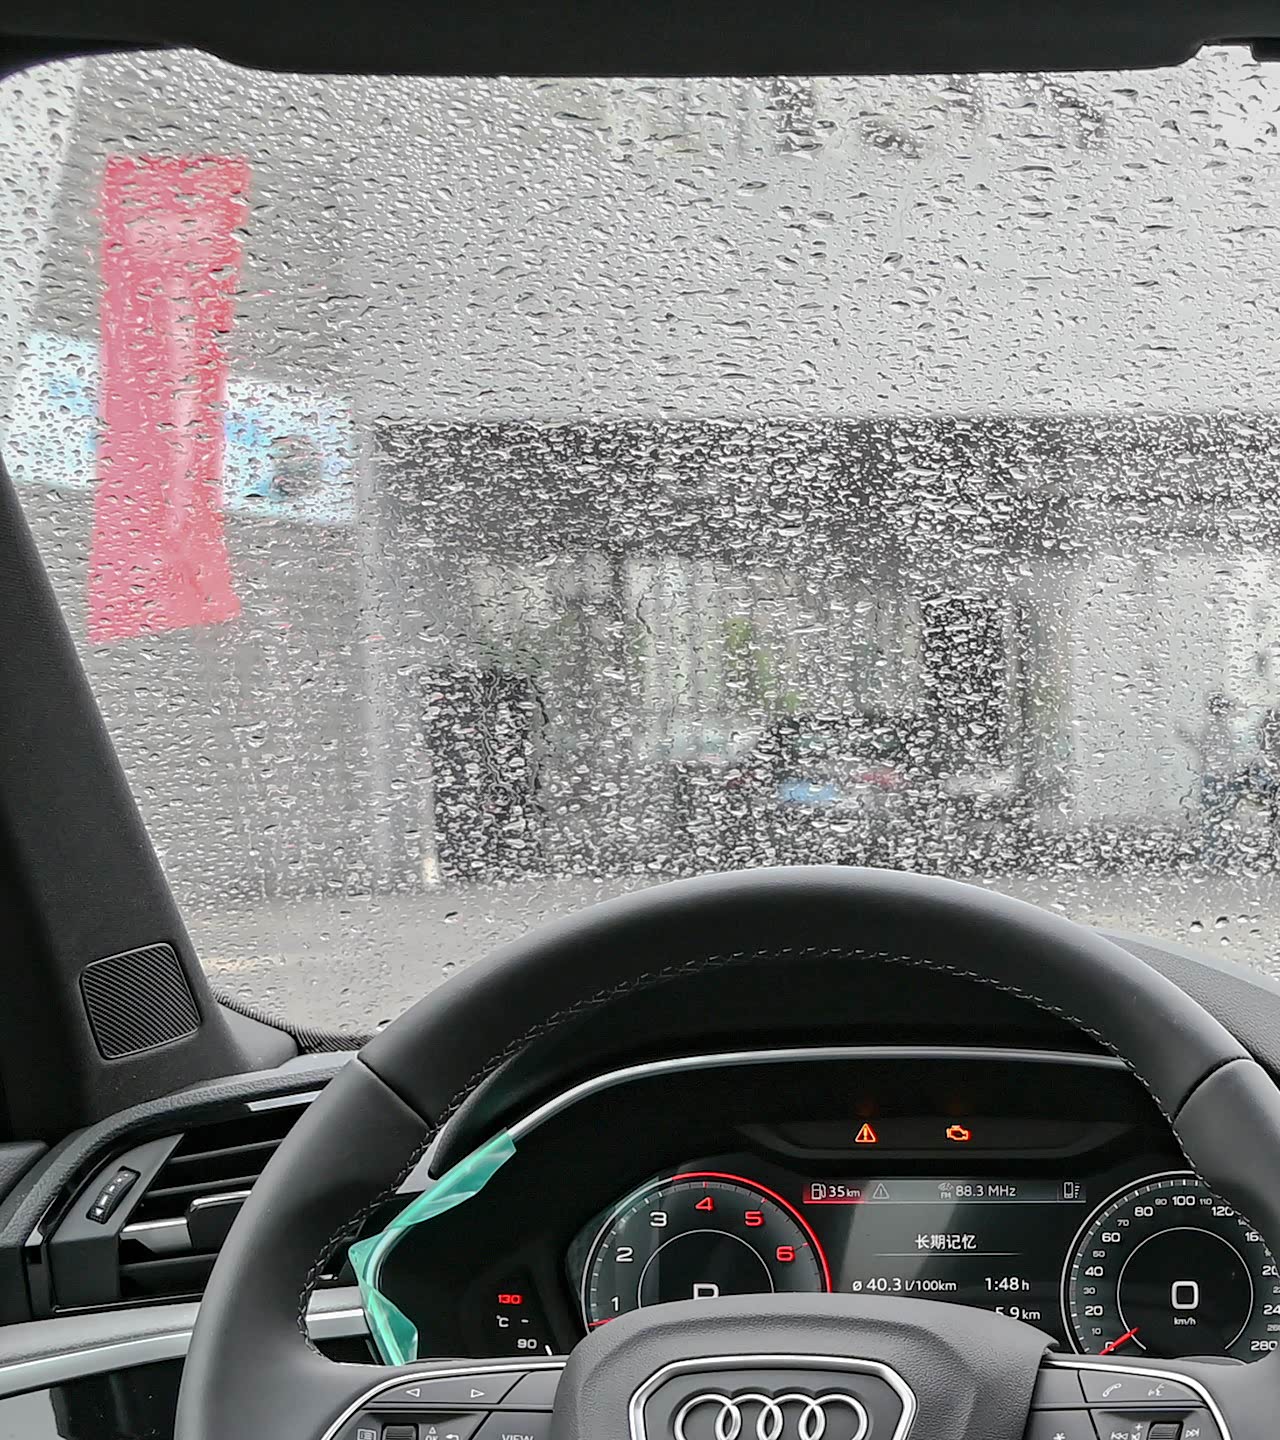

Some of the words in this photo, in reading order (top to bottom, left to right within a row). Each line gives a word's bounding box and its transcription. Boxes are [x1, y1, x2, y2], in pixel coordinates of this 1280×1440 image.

[828, 1185, 845, 1198] 35
[846, 1186, 861, 1198] km
[955, 1185, 984, 1197] 88.3
[987, 1185, 1017, 1197] MHz
[695, 1197, 714, 1211] 4
[1172, 1196, 1196, 1206] 100
[1199, 1198, 1213, 1206] 110
[1134, 1206, 1154, 1217] 80
[1211, 1206, 1235, 1217] 120
[650, 1211, 668, 1227] 3
[744, 1211, 764, 1227] 5
[1117, 1219, 1130, 1227] 70
[914, 1234, 977, 1251] 长期记忆
[1101, 1232, 1121, 1243] 60
[616, 1246, 634, 1262] 2
[776, 1245, 796, 1262] 6
[1092, 1250, 1105, 1258] 50
[1085, 1266, 1104, 1277] 40
[1262, 1265, 1278, 1276] 20
[866, 1277, 902, 1292] 40.3
[984, 1277, 1020, 1291] 1:48
[1021, 1279, 1030, 1291] h
[1083, 1287, 1096, 1295] 30
[1171, 1280, 1199, 1310] 0
[498, 1294, 522, 1304] 130
[610, 1296, 620, 1312] 1
[995, 1306, 1020, 1320] 59
[1021, 1309, 1041, 1320] km
[1084, 1305, 1103, 1316] 20
[1174, 1317, 1196, 1326] km/h
[1091, 1328, 1102, 1336] 10
[517, 1338, 538, 1349] 90
[1251, 1340, 1278, 1351] 280
